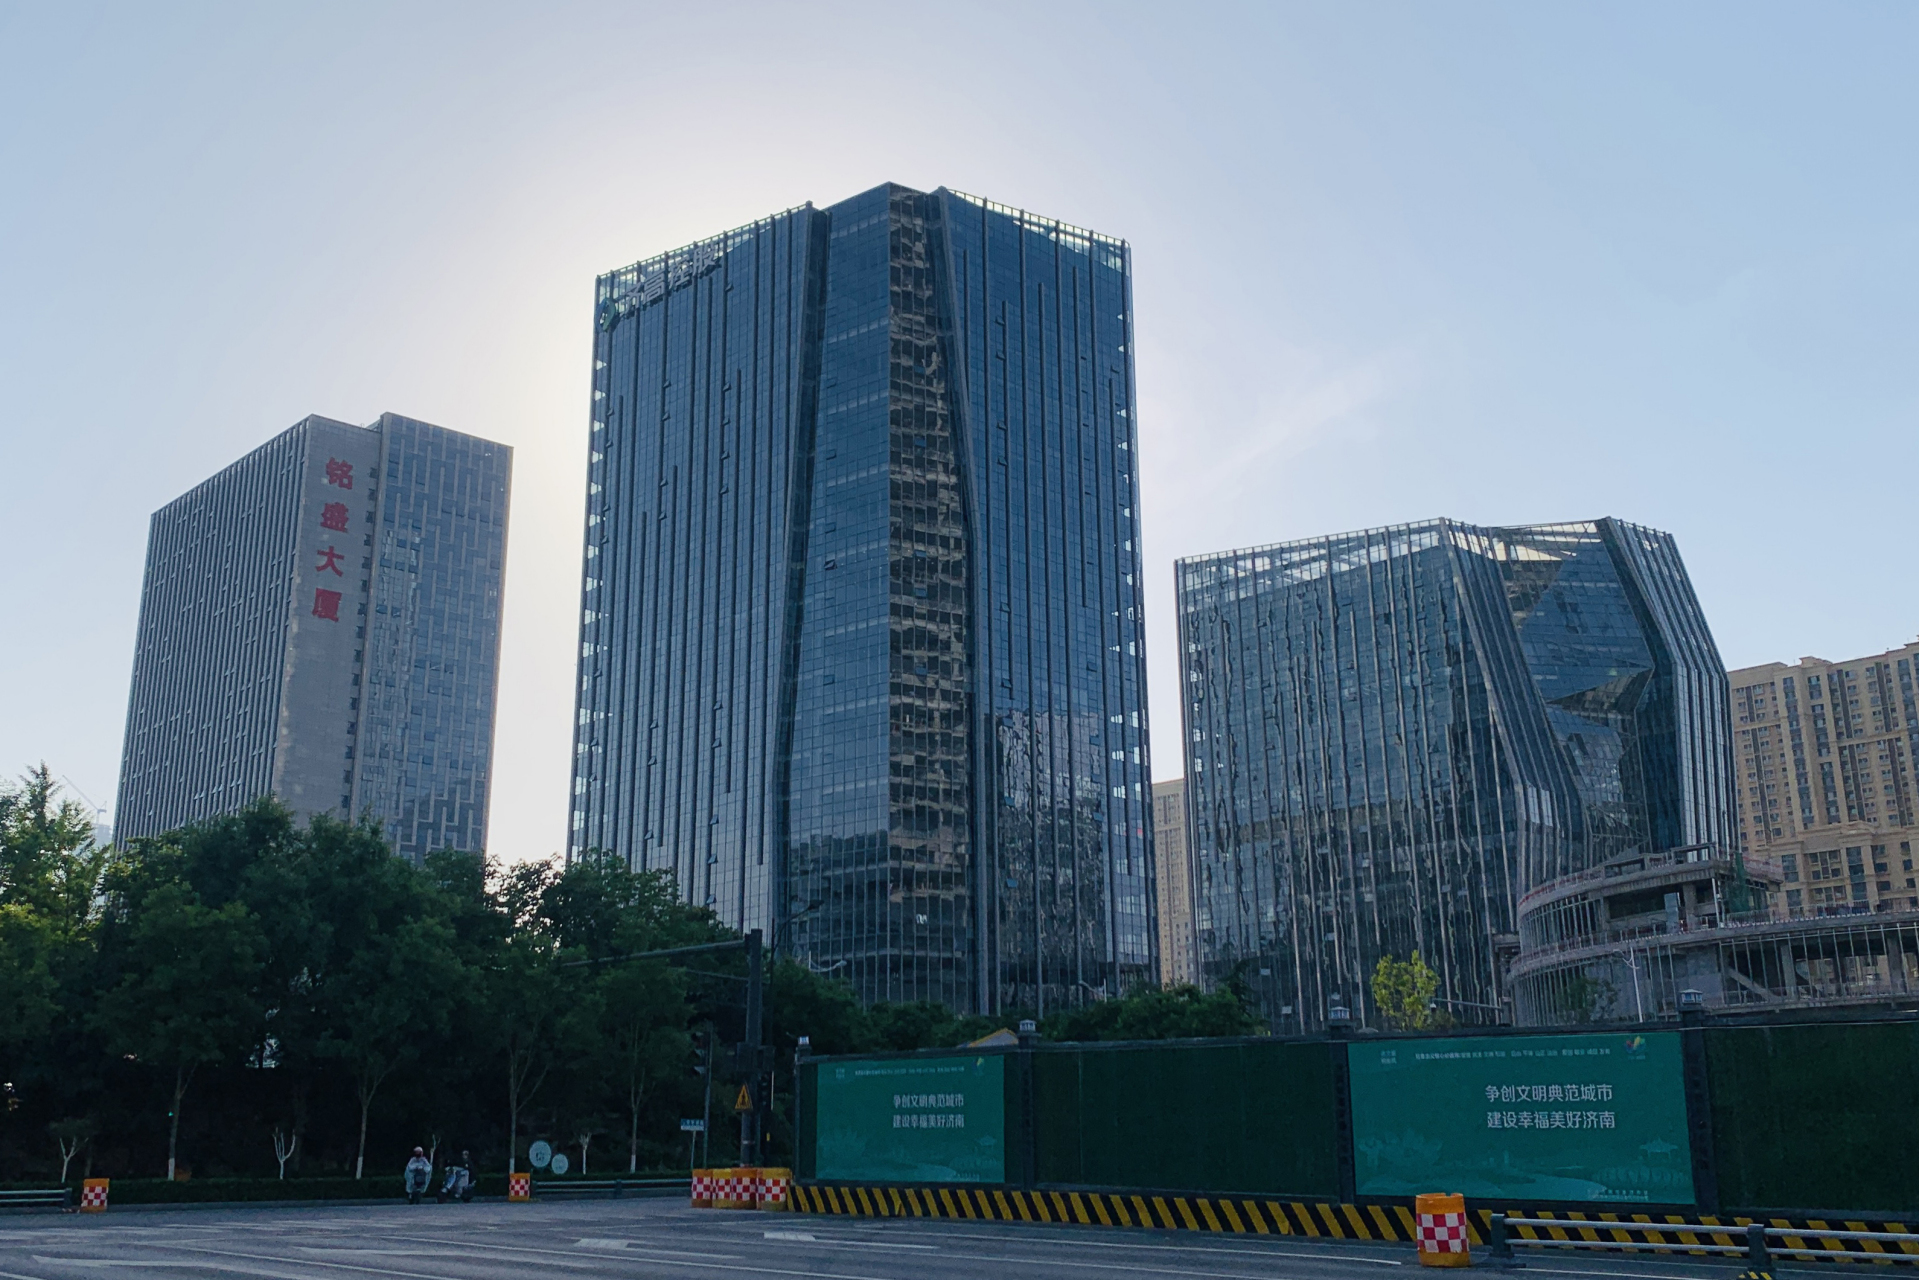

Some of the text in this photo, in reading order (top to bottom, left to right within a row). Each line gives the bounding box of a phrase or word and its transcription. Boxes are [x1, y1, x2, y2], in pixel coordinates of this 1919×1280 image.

[312, 456, 354, 623] 铭盛大厦
[892, 1093, 965, 1109] 争创文明典范城市
[1484, 1083, 1613, 1103] 争创文明典范城市
[892, 1113, 965, 1129] 建设幸福美好济南
[1486, 1111, 1616, 1129] 建设幸福美好济南
